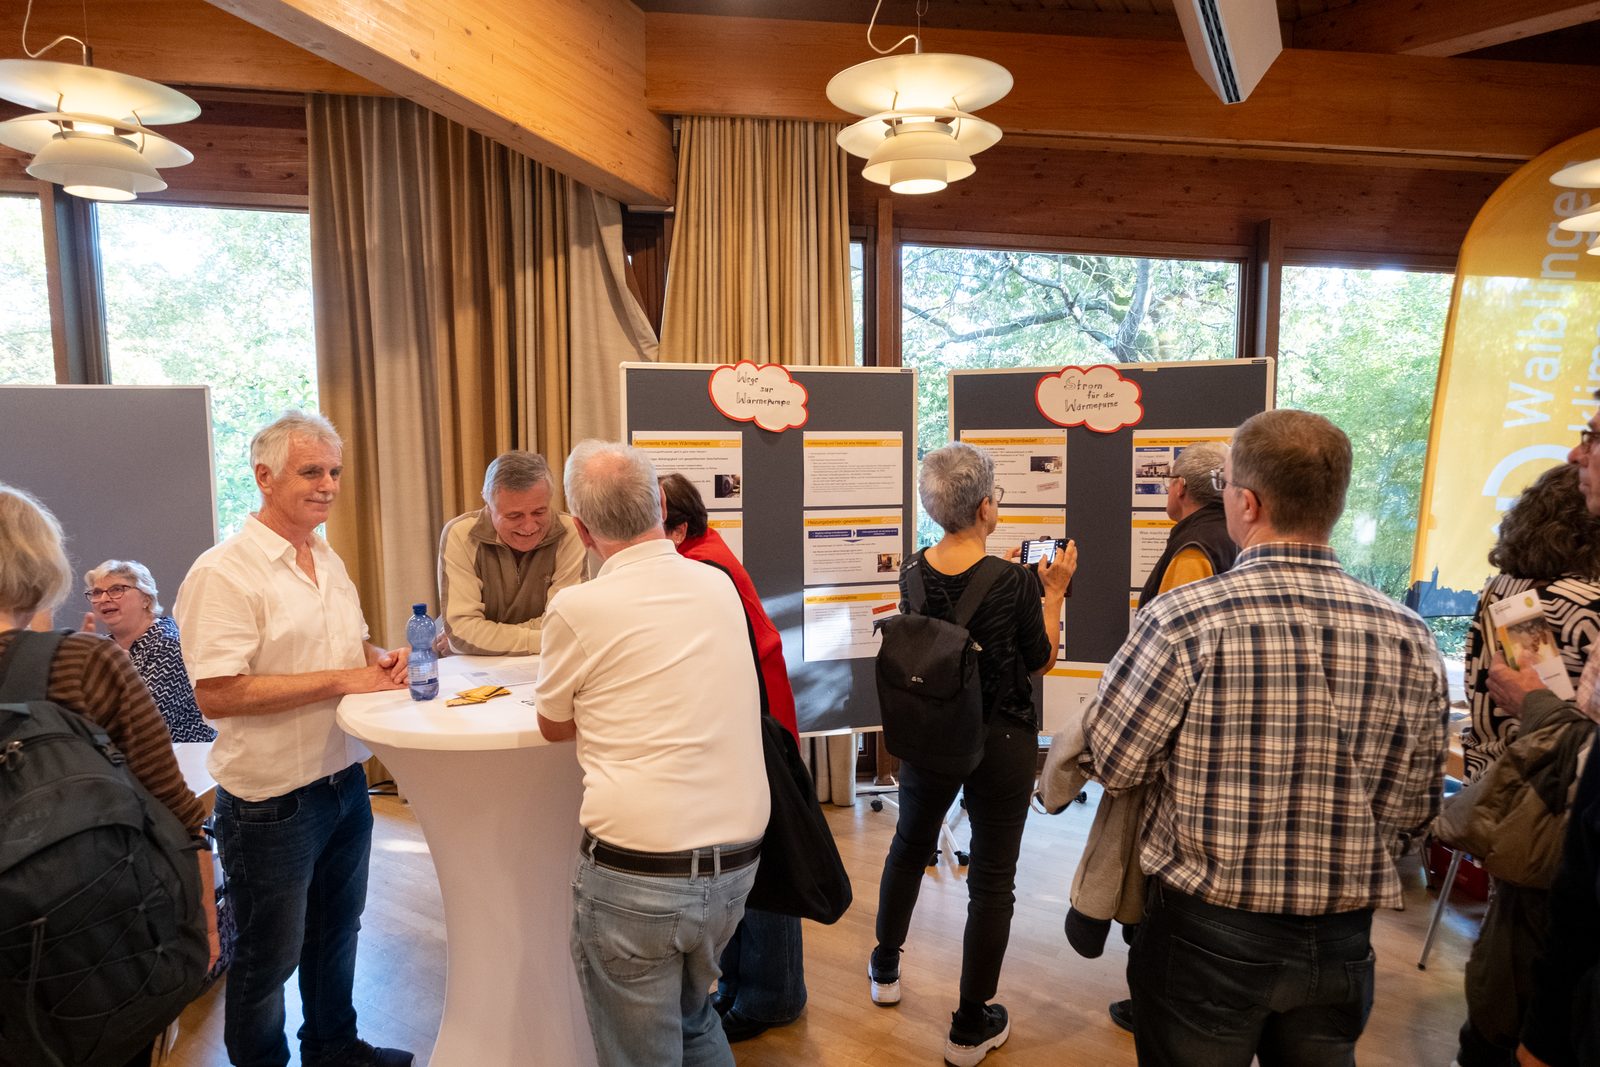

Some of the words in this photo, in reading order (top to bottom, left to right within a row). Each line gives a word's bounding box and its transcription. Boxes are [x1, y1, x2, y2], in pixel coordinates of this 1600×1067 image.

[1503, 160, 1598, 428] Waiblinge
[736, 371, 759, 386] Wege
[1063, 375, 1103, 390] Strom
[736, 392, 791, 406] Wärmepumpe
[1087, 390, 1100, 399] für
